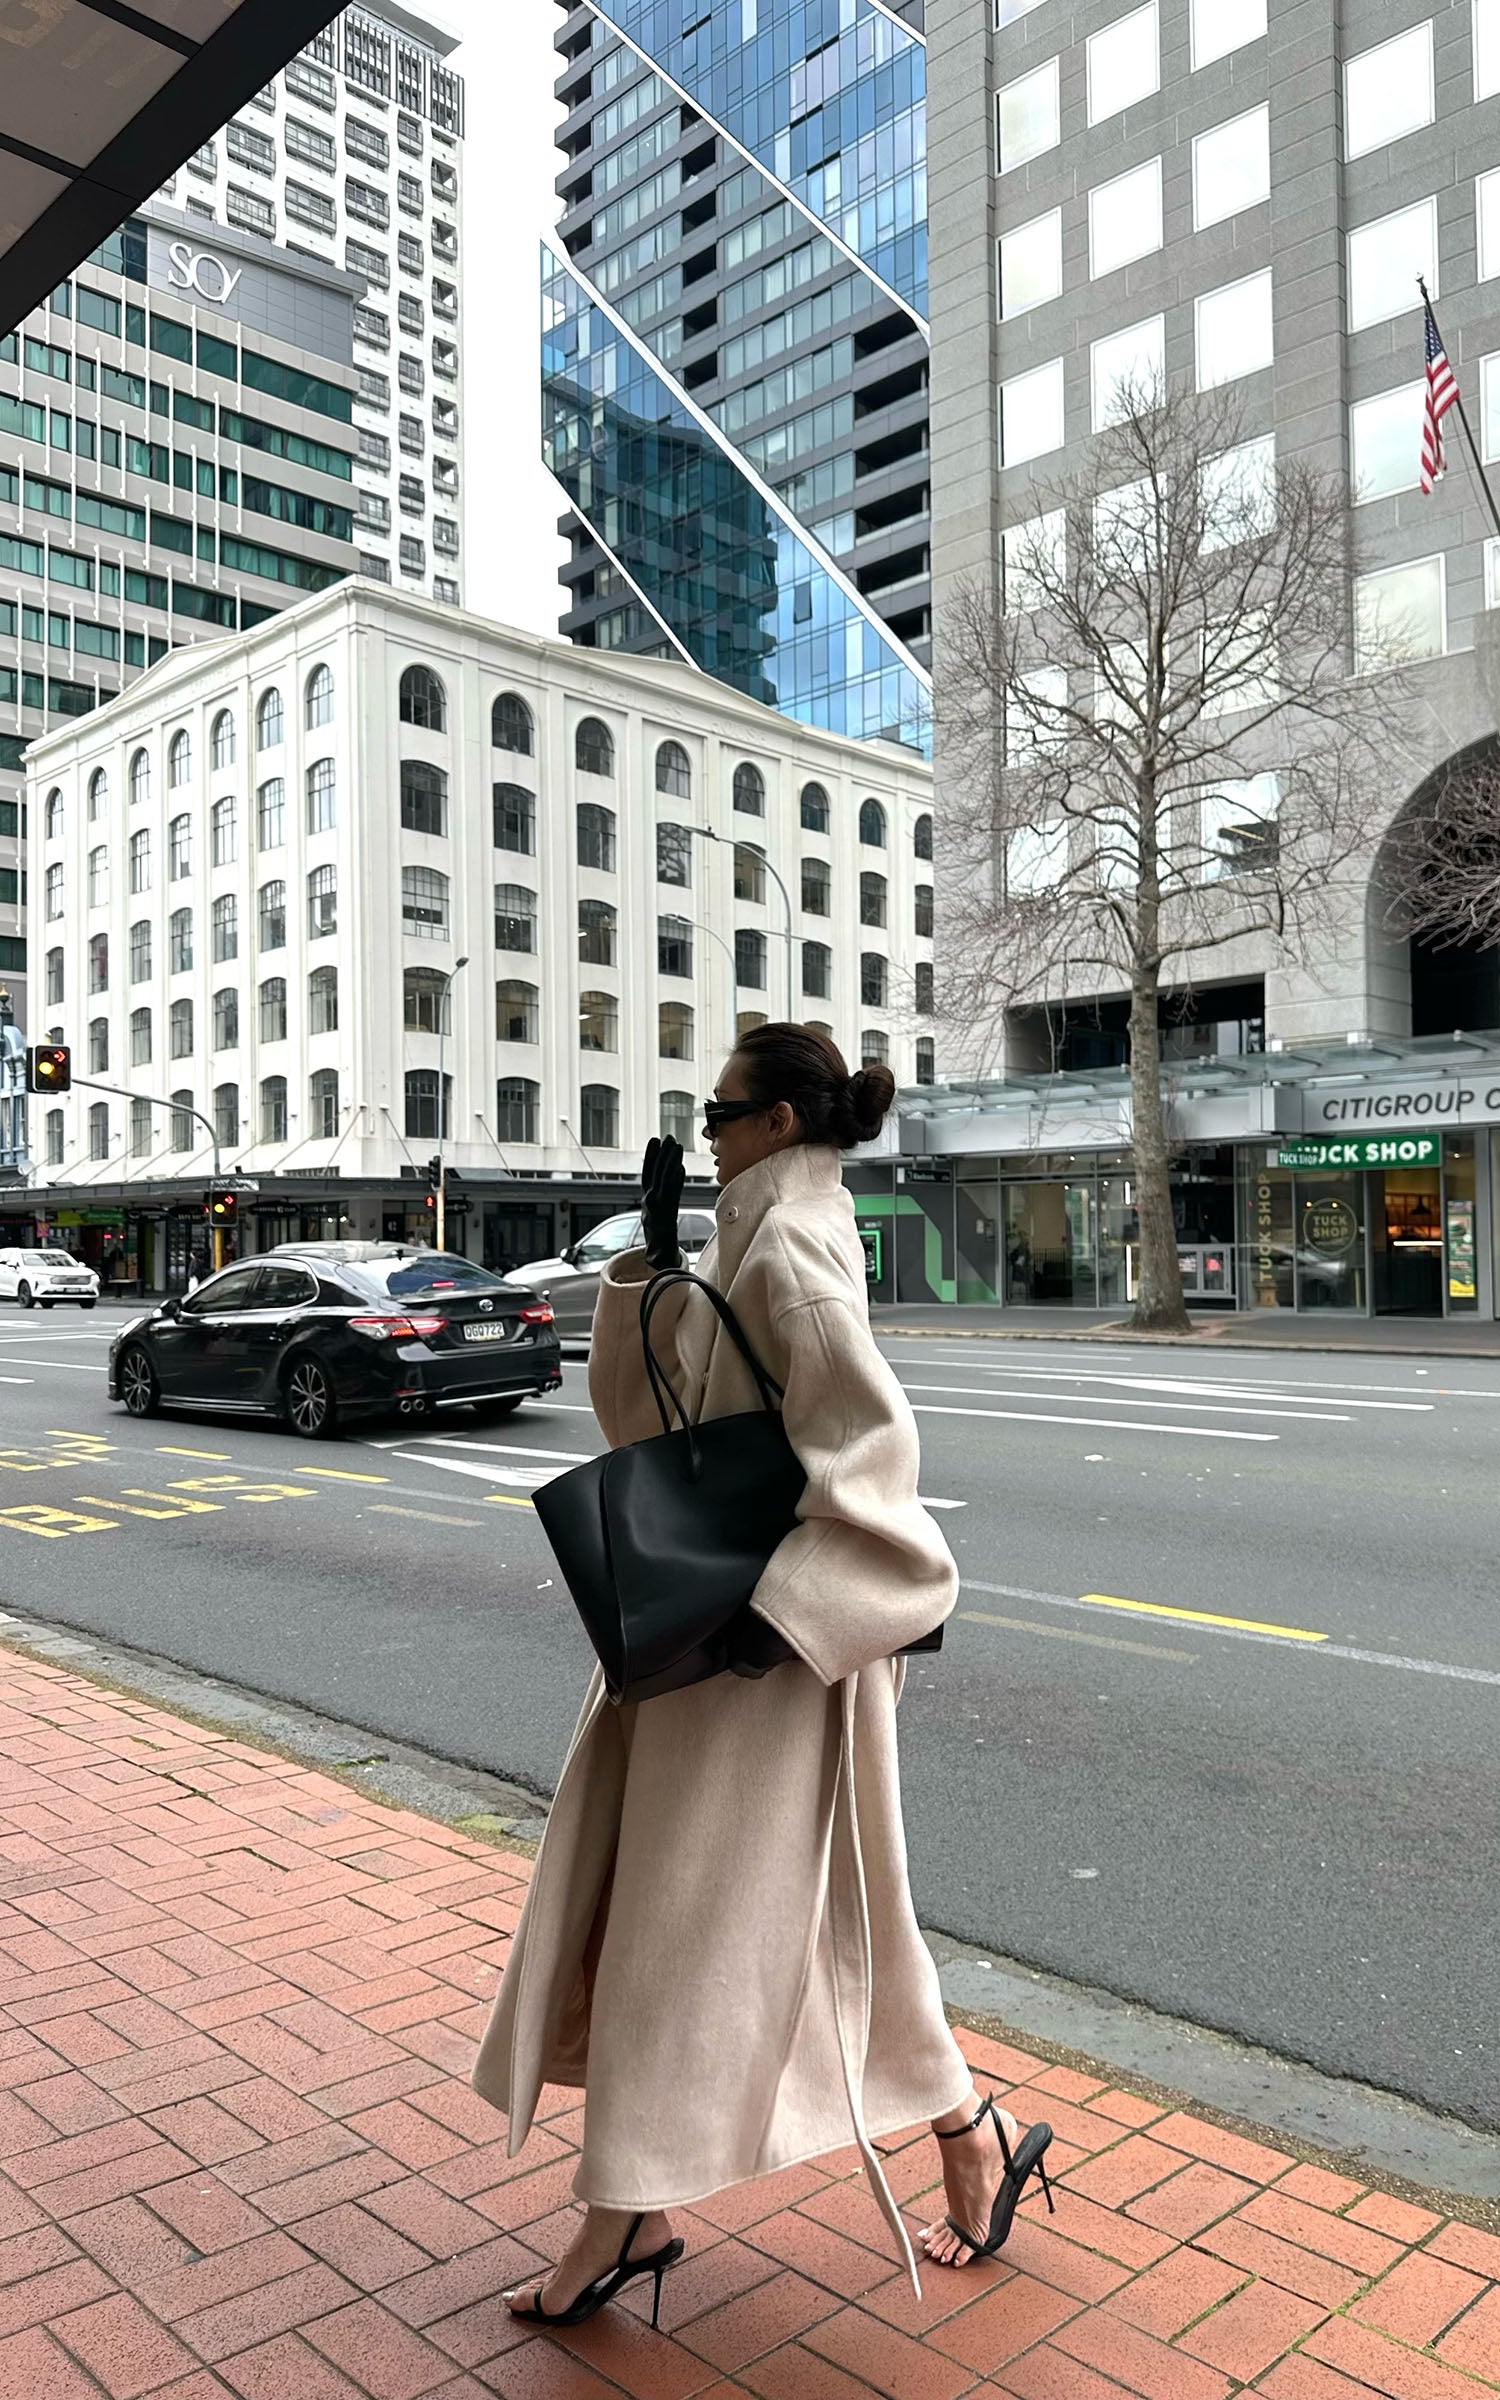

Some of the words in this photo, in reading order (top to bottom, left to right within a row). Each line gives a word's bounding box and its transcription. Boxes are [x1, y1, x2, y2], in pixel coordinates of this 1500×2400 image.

[1322, 1090, 1475, 1121] CITIGROUP
[1485, 1088, 1500, 1110] C
[1279, 1152, 1298, 1165] TUCK
[1299, 1153, 1318, 1165] SHOP
[1366, 1140, 1434, 1161] SHOP
[1257, 1173, 1271, 1226] SHOP
[1312, 1215, 1348, 1226] TUCK
[1312, 1225, 1349, 1238] SHOP
[1259, 1231, 1273, 1282] TUCK
[0, 1475, 319, 1538] BUS
